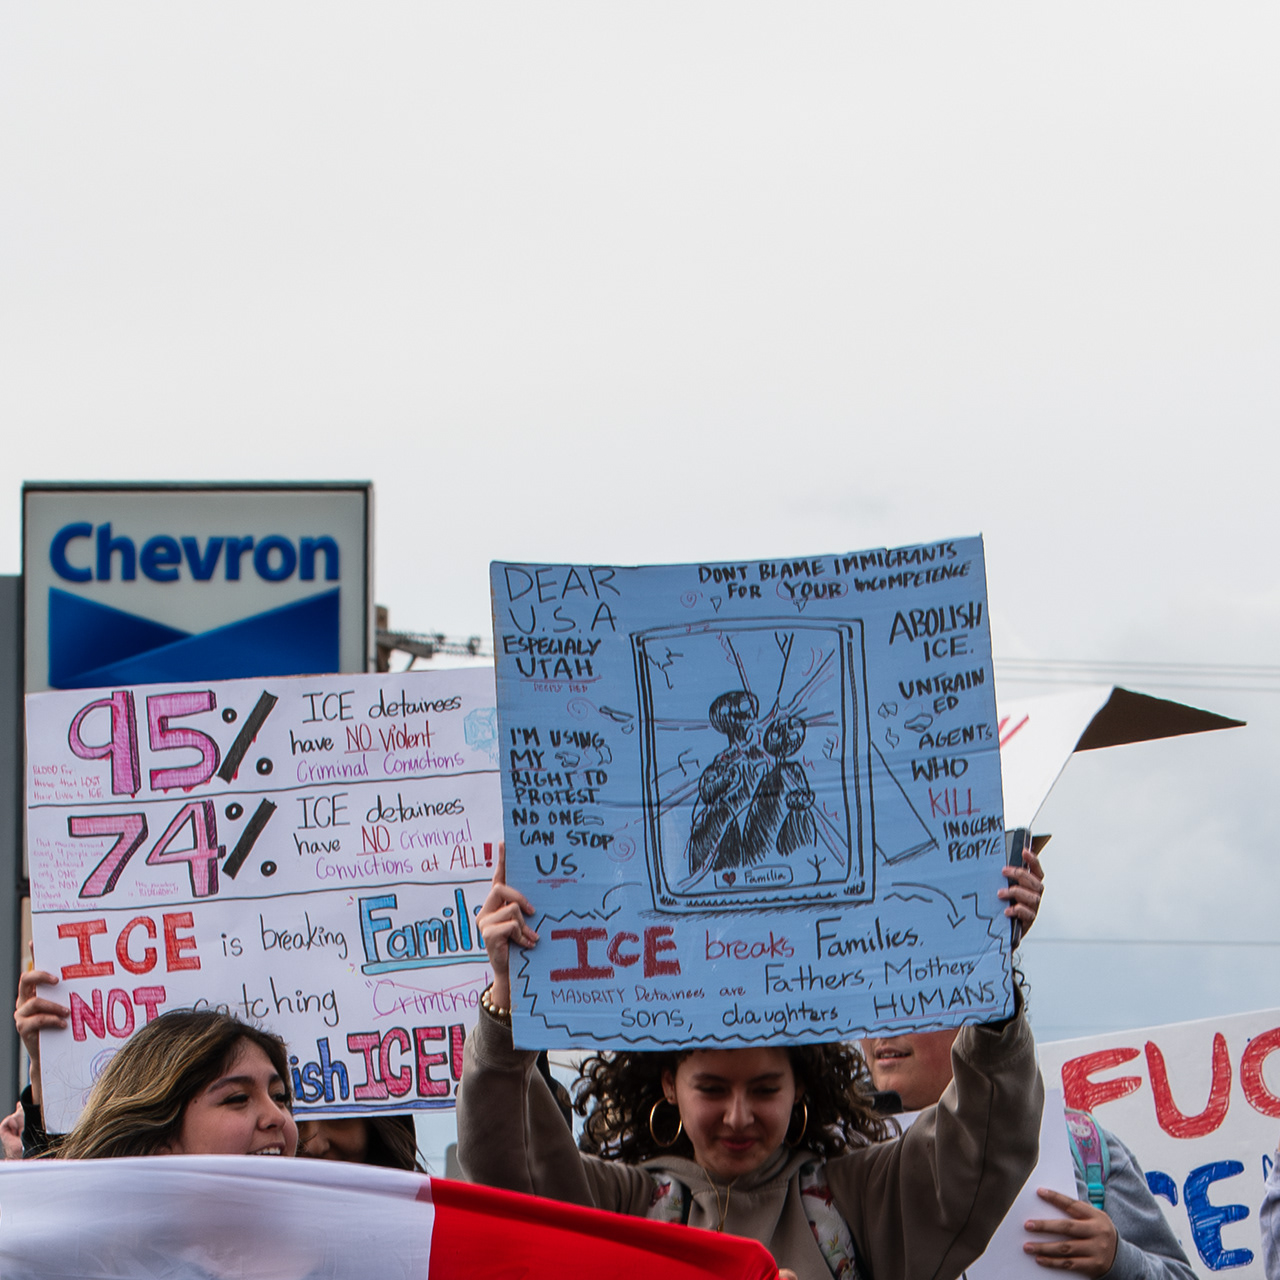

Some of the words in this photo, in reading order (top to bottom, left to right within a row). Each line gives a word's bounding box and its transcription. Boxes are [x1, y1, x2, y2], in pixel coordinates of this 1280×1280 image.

[49, 521, 340, 583] Chevron
[698, 564, 749, 584] DONT
[759, 558, 826, 581] BLAME
[834, 541, 959, 576] IMMIGRANTS
[504, 566, 621, 604] DEAR
[727, 583, 762, 600] FOR
[783, 580, 843, 600] YOUR
[854, 560, 973, 593] INCOMPETENCE
[888, 601, 983, 646] ABOLISH
[516, 657, 594, 680] UTAH
[898, 666, 986, 700] UNTRAIN
[302, 690, 355, 724] ICE
[368, 688, 463, 719] detainees
[933, 695, 960, 714] ED
[67, 689, 280, 799] 95%
[289, 729, 334, 756] have
[346, 723, 372, 751] NO
[510, 727, 541, 747] I'M
[549, 729, 605, 750] USING
[919, 723, 993, 751] AGENTS
[296, 753, 369, 783] Criminal
[383, 750, 465, 775] Convictions
[510, 749, 545, 769] MY
[911, 757, 969, 782] WHO
[511, 770, 579, 789] RIGHT
[584, 769, 609, 787] TO
[296, 792, 351, 829] ICE
[366, 793, 465, 824] detainees
[511, 808, 540, 827] NO
[548, 808, 584, 826] ONE
[928, 786, 981, 819] KILL
[67, 798, 279, 898] 74%
[293, 832, 341, 856] have
[361, 825, 390, 853] NO
[521, 829, 556, 847] CAN
[569, 830, 615, 851] STOP
[948, 836, 1003, 864] PEOPLE
[315, 856, 414, 880] Convictions
[421, 854, 440, 872] at
[450, 842, 494, 871] ALL!
[744, 869, 787, 885] Familia
[57, 911, 202, 981] ICE
[220, 933, 244, 958] is
[259, 911, 350, 960] breaking
[549, 925, 682, 983] ICE
[705, 930, 795, 961] breaks
[815, 916, 924, 961] Families.
[551, 987, 625, 1005] MAJORITY
[635, 984, 706, 1002] Detainees
[719, 986, 747, 998] are
[765, 963, 874, 996] Fathers,
[884, 956, 975, 985] Mothers
[69, 984, 168, 1043] NOT
